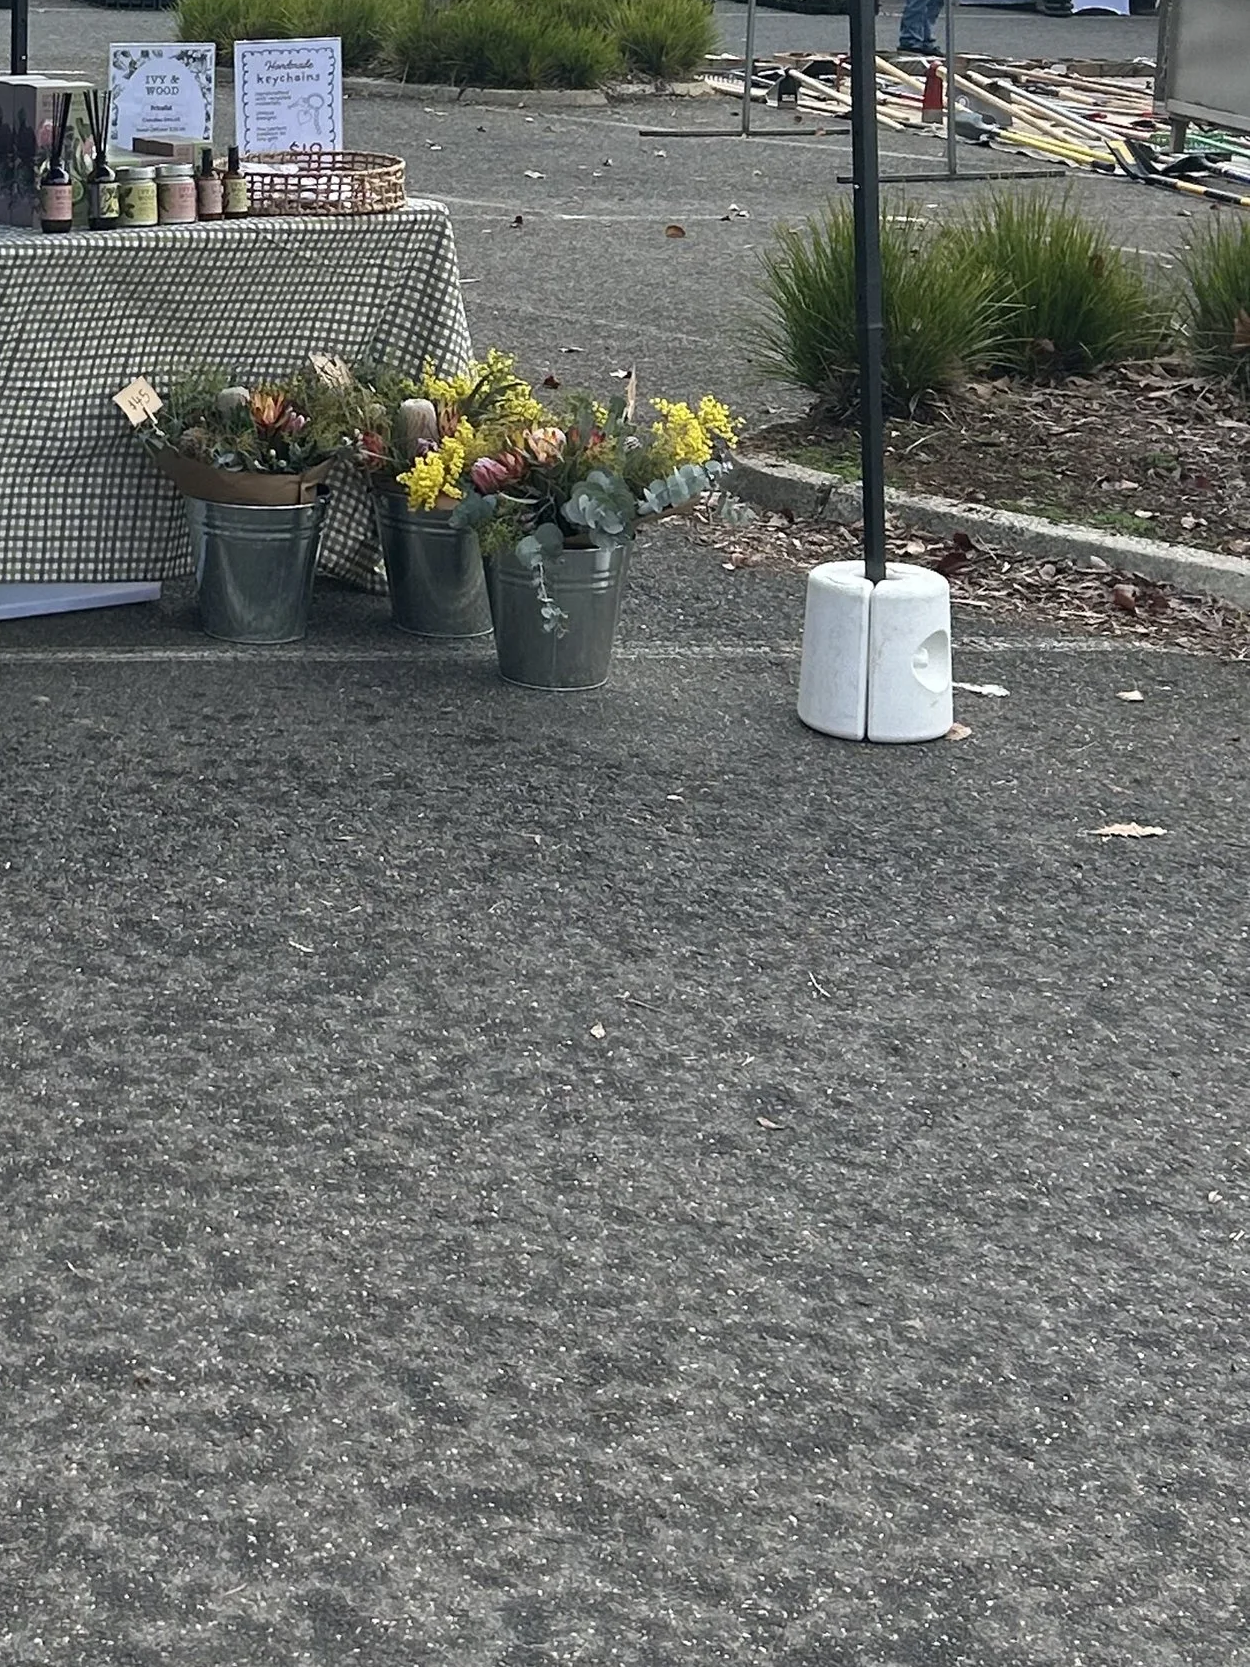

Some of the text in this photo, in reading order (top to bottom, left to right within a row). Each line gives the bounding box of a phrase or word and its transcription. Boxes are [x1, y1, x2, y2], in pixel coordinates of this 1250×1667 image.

[145, 74, 180, 84] IVY &
[257, 72, 321, 87] keychains
[145, 85, 180, 95] WOOD
